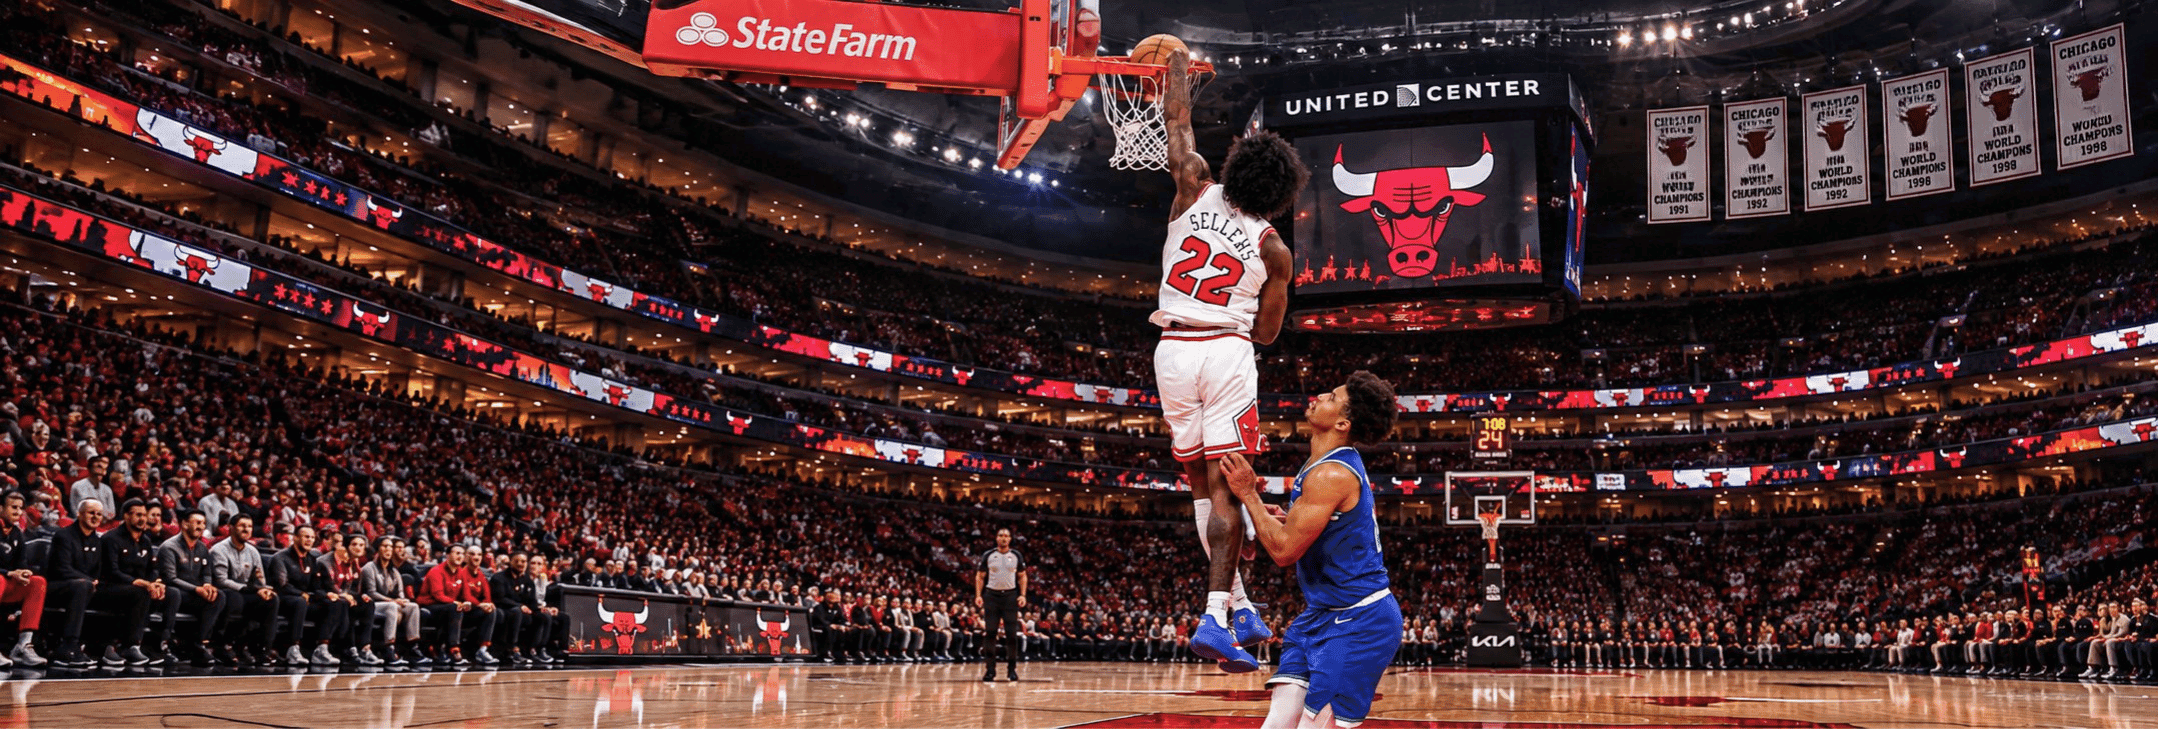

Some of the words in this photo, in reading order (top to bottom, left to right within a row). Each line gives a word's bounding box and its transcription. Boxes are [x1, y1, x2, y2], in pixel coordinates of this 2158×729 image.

[2059, 36, 2116, 60] CHICAGO
[1286, 91, 1389, 115] UNITED
[1427, 80, 1540, 101] CENTER
[1731, 106, 1779, 121] CHICAGO
[1984, 135, 2021, 150] WORLD
[1900, 152, 1936, 167] WORLD
[1907, 176, 1931, 189] 1998
[1825, 189, 1848, 200] 1992
[1669, 205, 1689, 215] 1991
[1746, 199, 1768, 209] 1992
[1166, 235, 1245, 307] 22
[1478, 430, 1503, 450] 24
[1472, 635, 1515, 647] KIA
